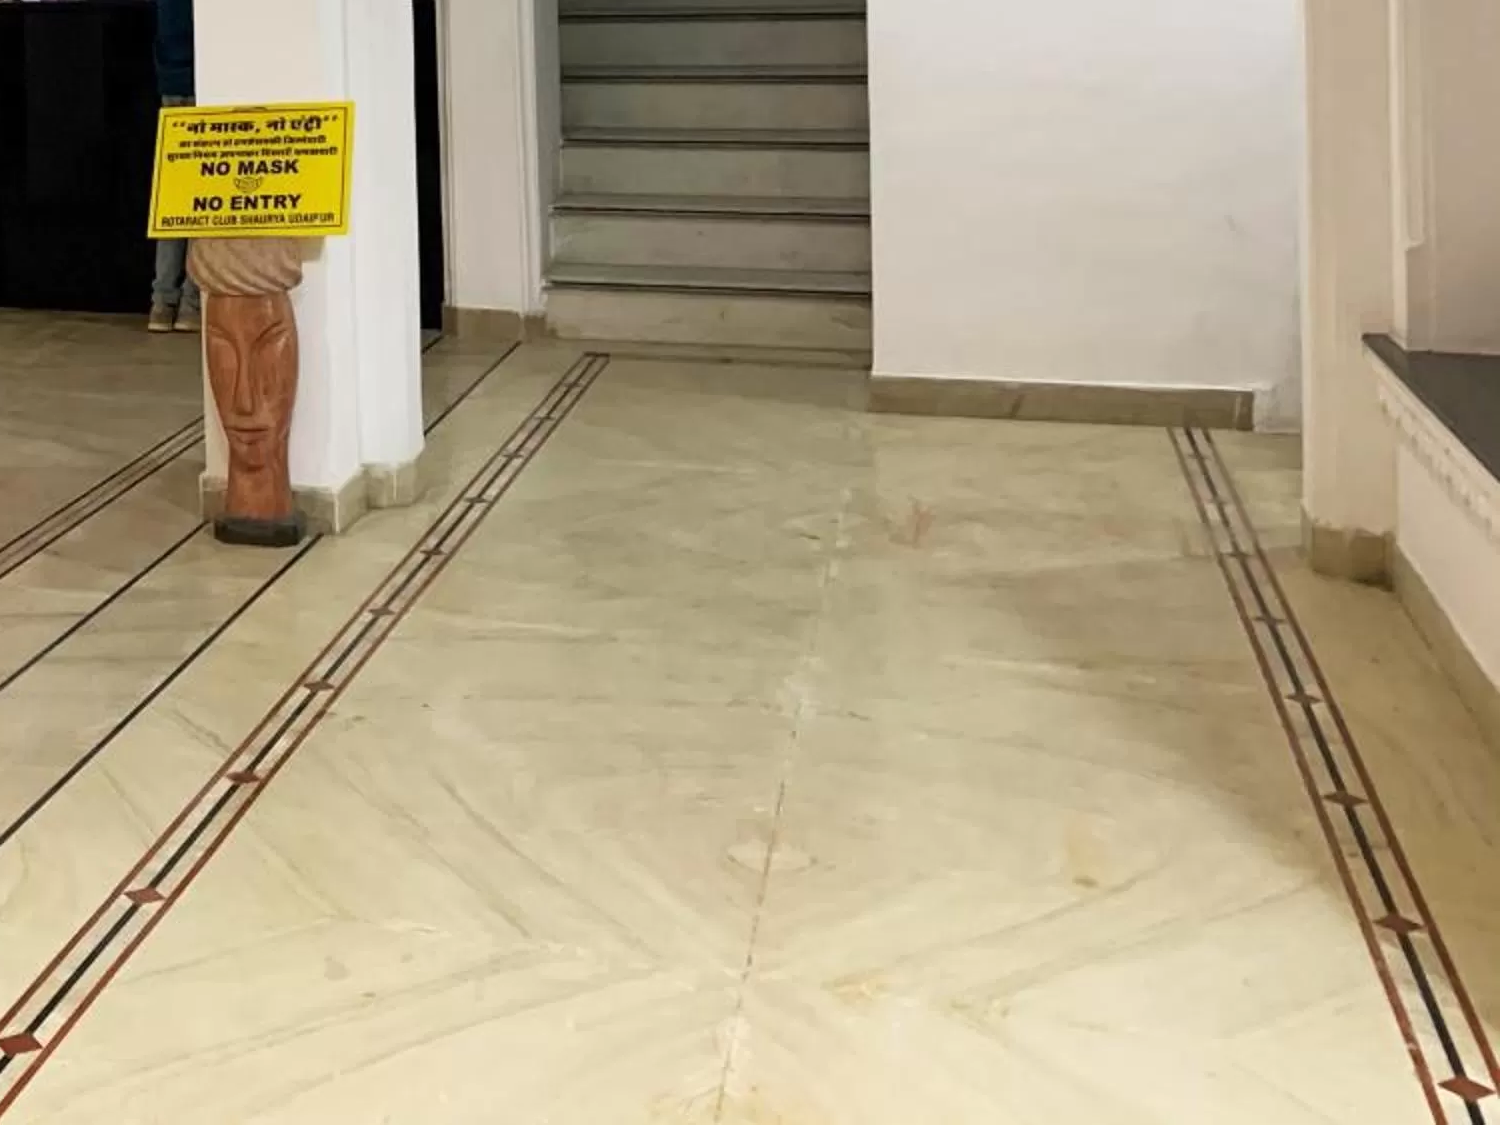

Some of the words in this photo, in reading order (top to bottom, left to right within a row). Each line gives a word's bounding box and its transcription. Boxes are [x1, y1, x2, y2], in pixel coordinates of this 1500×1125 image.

[201, 162, 231, 176] NO
[237, 159, 299, 175] MASK
[193, 196, 223, 211] NO
[230, 194, 301, 210] ENTRY
[162, 215, 210, 227] ROTARACT
[212, 214, 236, 226] CLUB
[240, 213, 285, 225] SHAURYA
[288, 212, 334, 224] UDAIPUR
